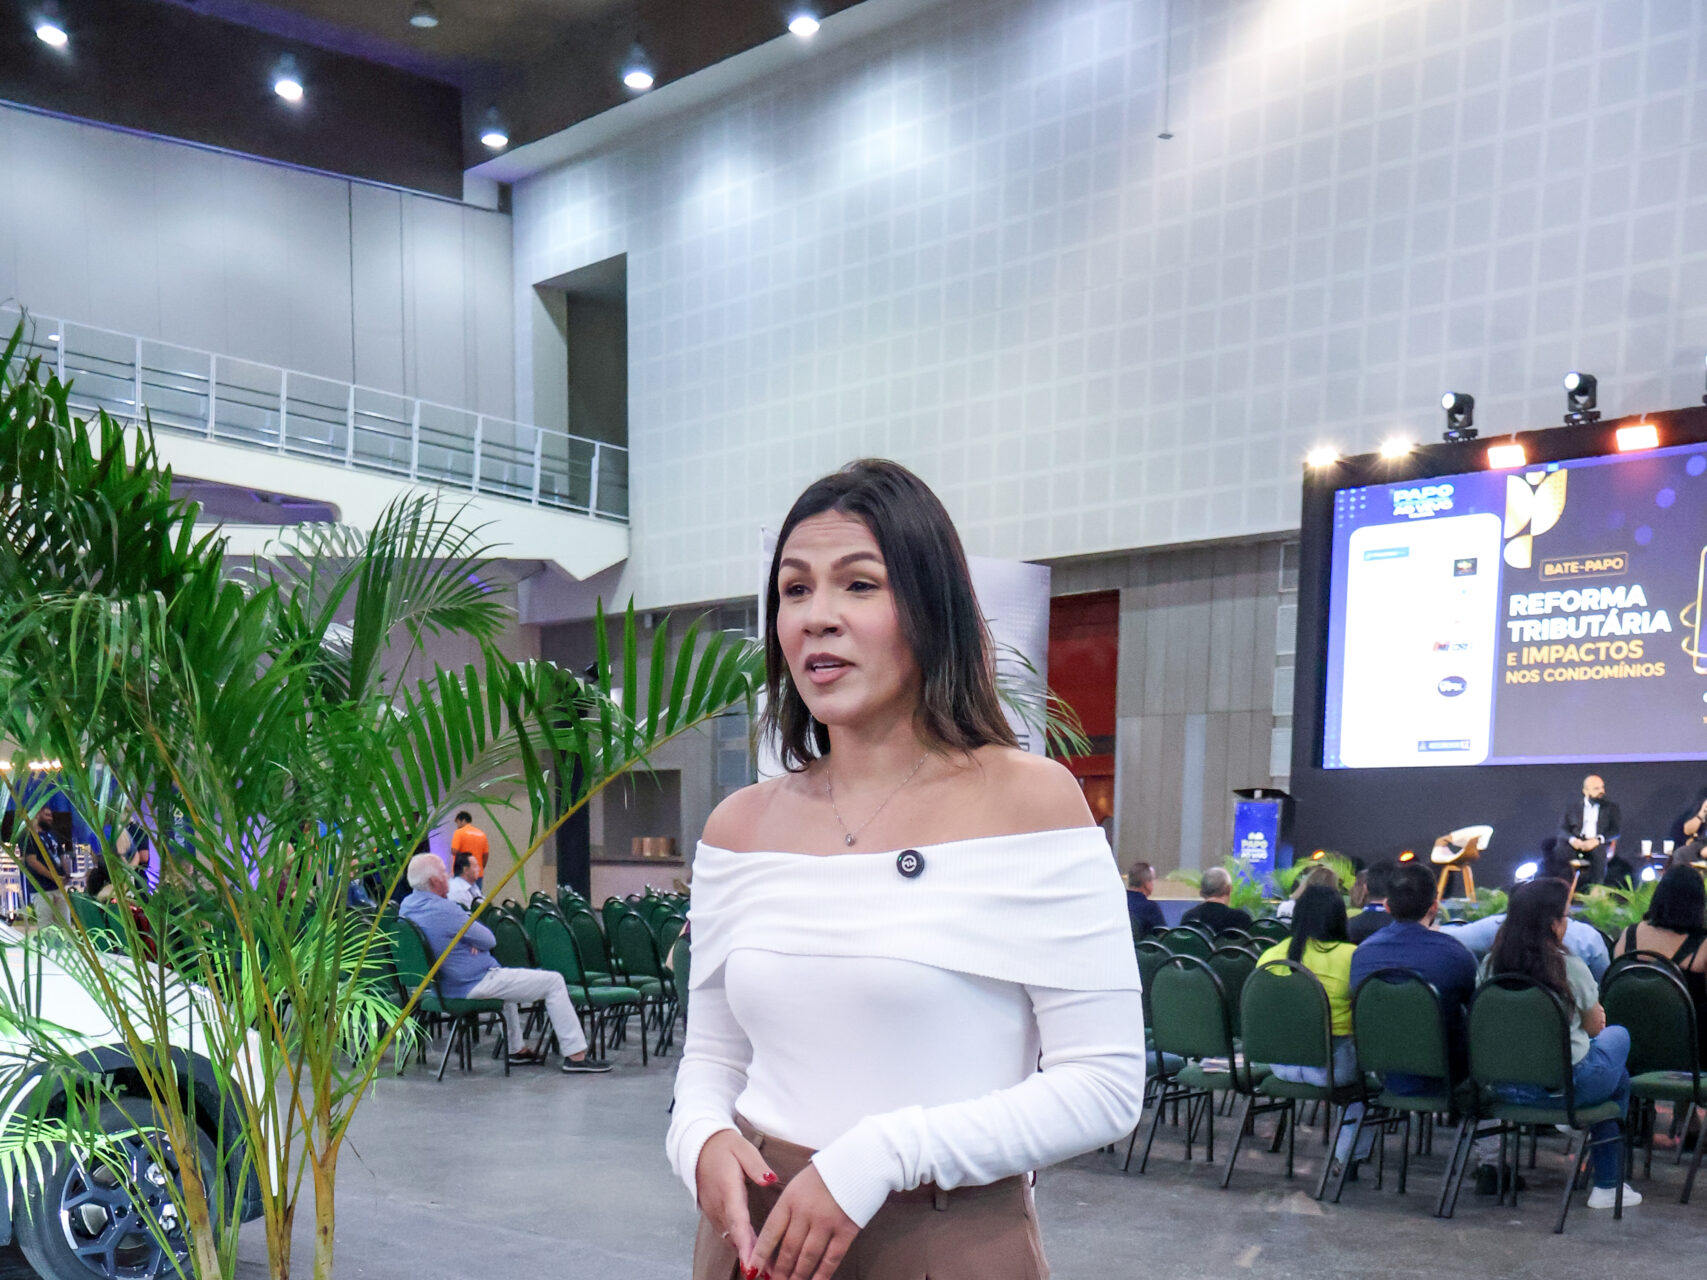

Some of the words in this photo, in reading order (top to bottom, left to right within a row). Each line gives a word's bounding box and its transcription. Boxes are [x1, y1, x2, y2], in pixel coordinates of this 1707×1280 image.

[1393, 484, 1454, 504] PAPO
[1544, 558, 1625, 576] BATE-PAPO
[1509, 584, 1647, 617] REFORMA
[1507, 607, 1672, 643] TRIBUTÁRIA
[1506, 652, 1518, 667] E
[1521, 639, 1644, 666] IMPACTOS
[1505, 669, 1541, 685] NOS
[1543, 661, 1666, 683] CONDOMÍNIOS
